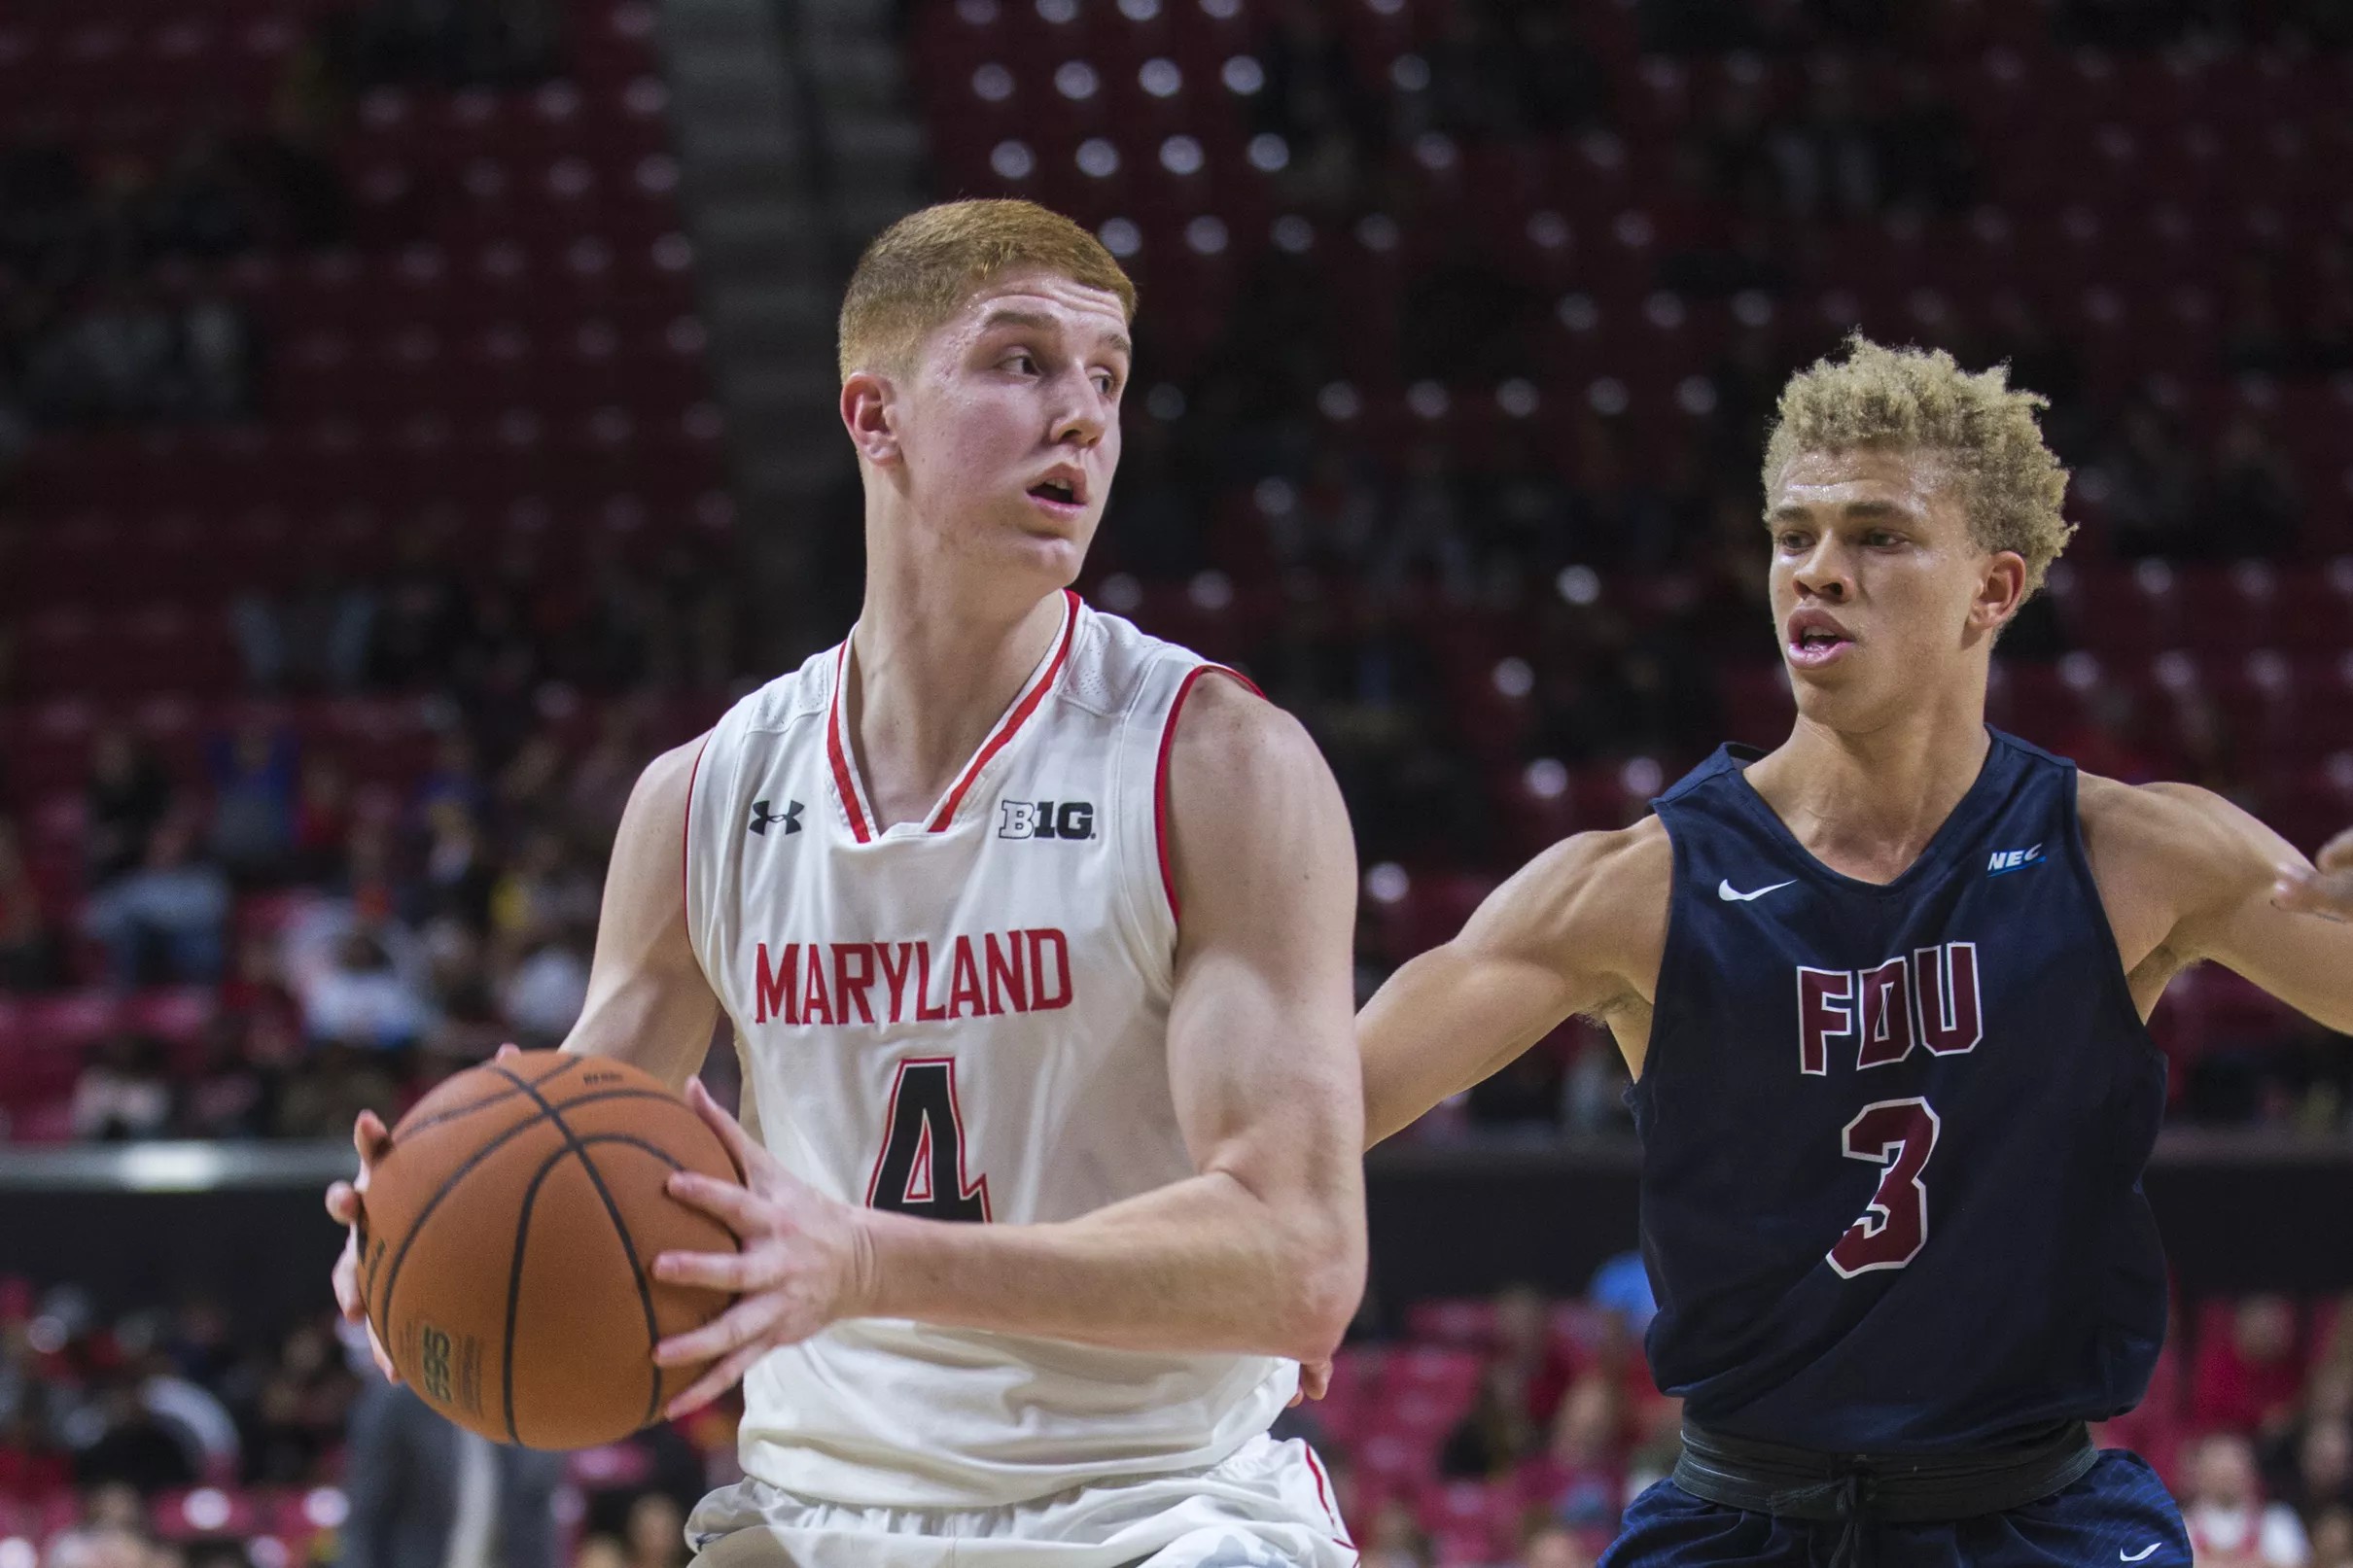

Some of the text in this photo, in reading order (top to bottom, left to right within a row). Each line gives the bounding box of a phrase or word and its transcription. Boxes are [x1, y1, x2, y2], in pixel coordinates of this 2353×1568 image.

[1987, 842, 2043, 871] NEC
[755, 927, 1074, 1026] MARYLAND
[1797, 942, 1983, 1076] FDU
[865, 1056, 993, 1225] 4
[1825, 1097, 1940, 1279] 3
